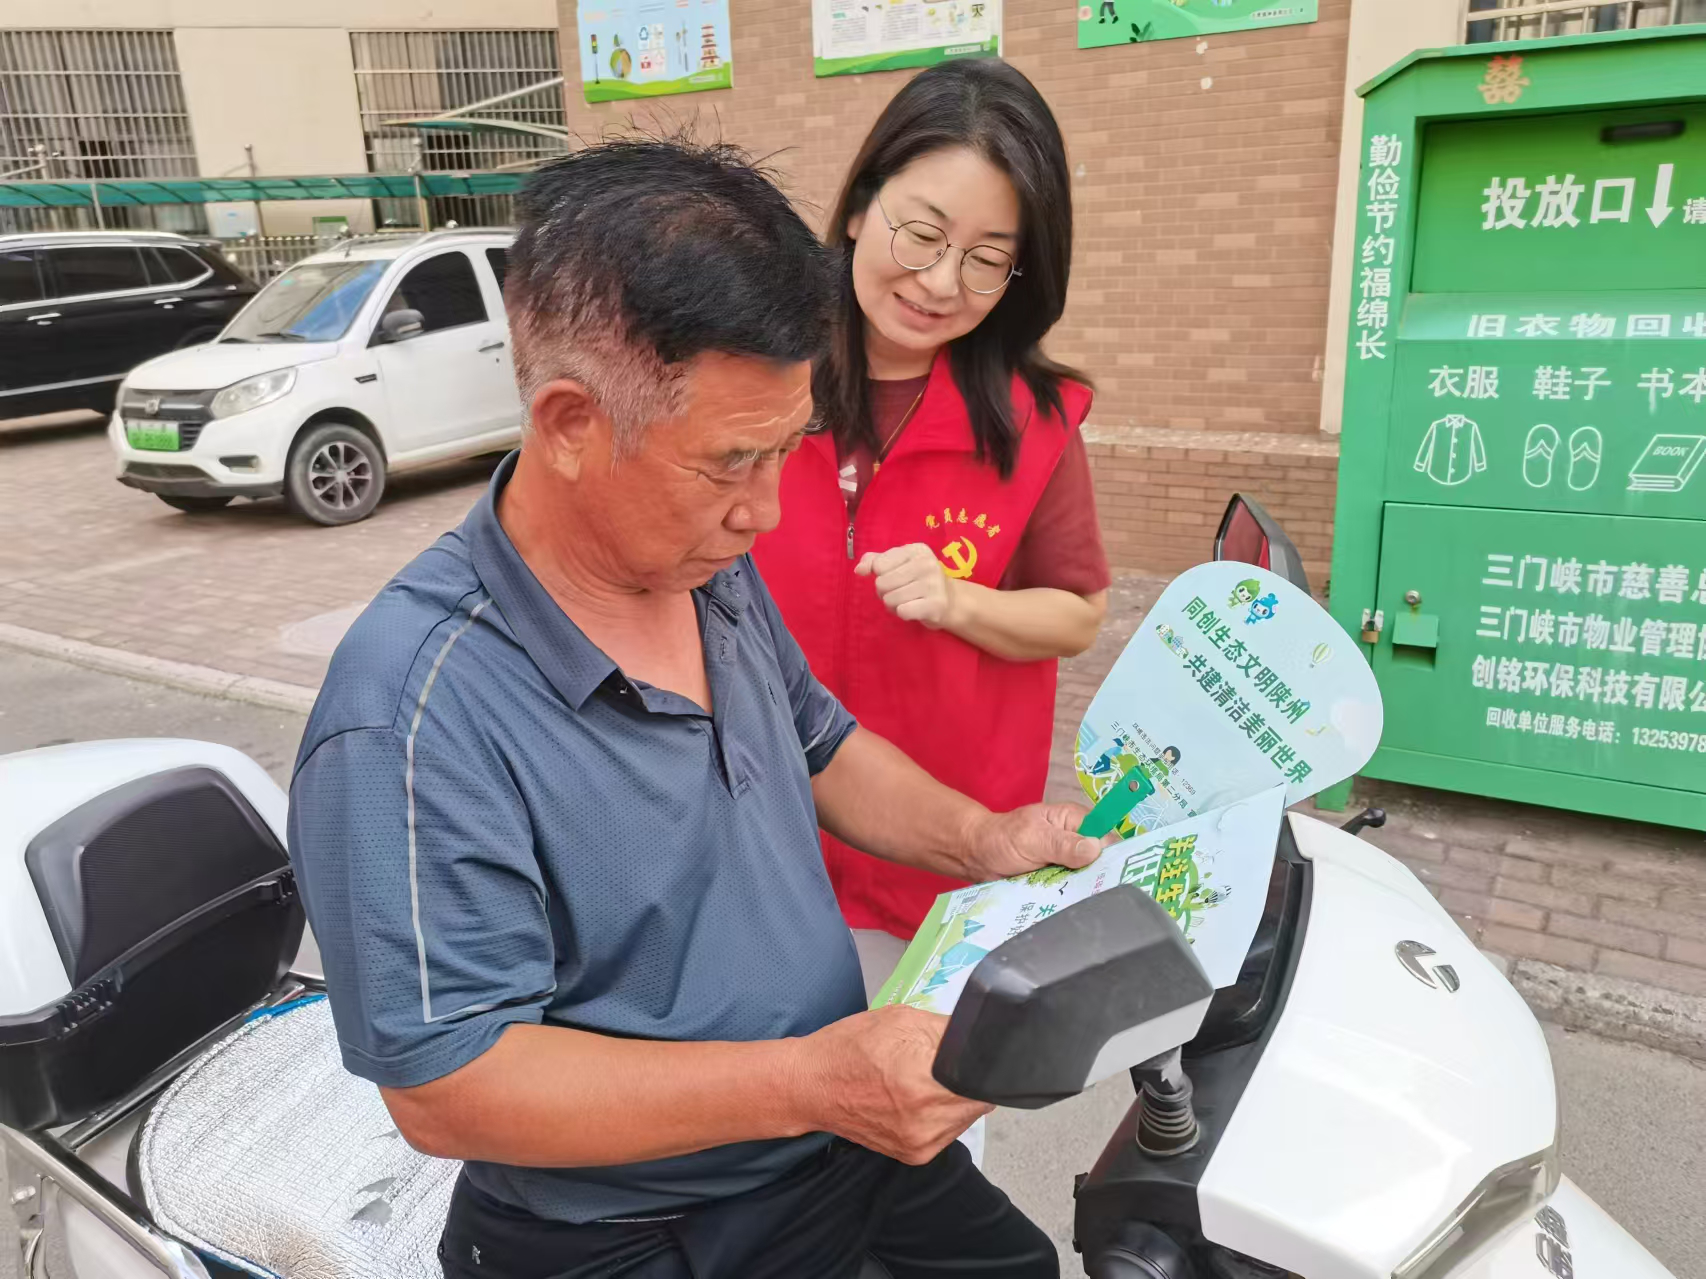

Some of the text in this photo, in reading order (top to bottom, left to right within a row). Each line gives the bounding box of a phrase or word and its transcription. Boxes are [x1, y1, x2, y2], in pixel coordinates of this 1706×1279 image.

[1355, 133, 1402, 360] 勤俭节约福绵长
[1481, 173, 1636, 230] 投放口
[1428, 364, 1500, 399] 衣服
[1532, 364, 1612, 401] 鞋子
[1652, 445, 1689, 457] BOOK
[1182, 595, 1311, 725] 同创生态文明陕州
[1183, 653, 1313, 785] 共建清洁美丽世界
